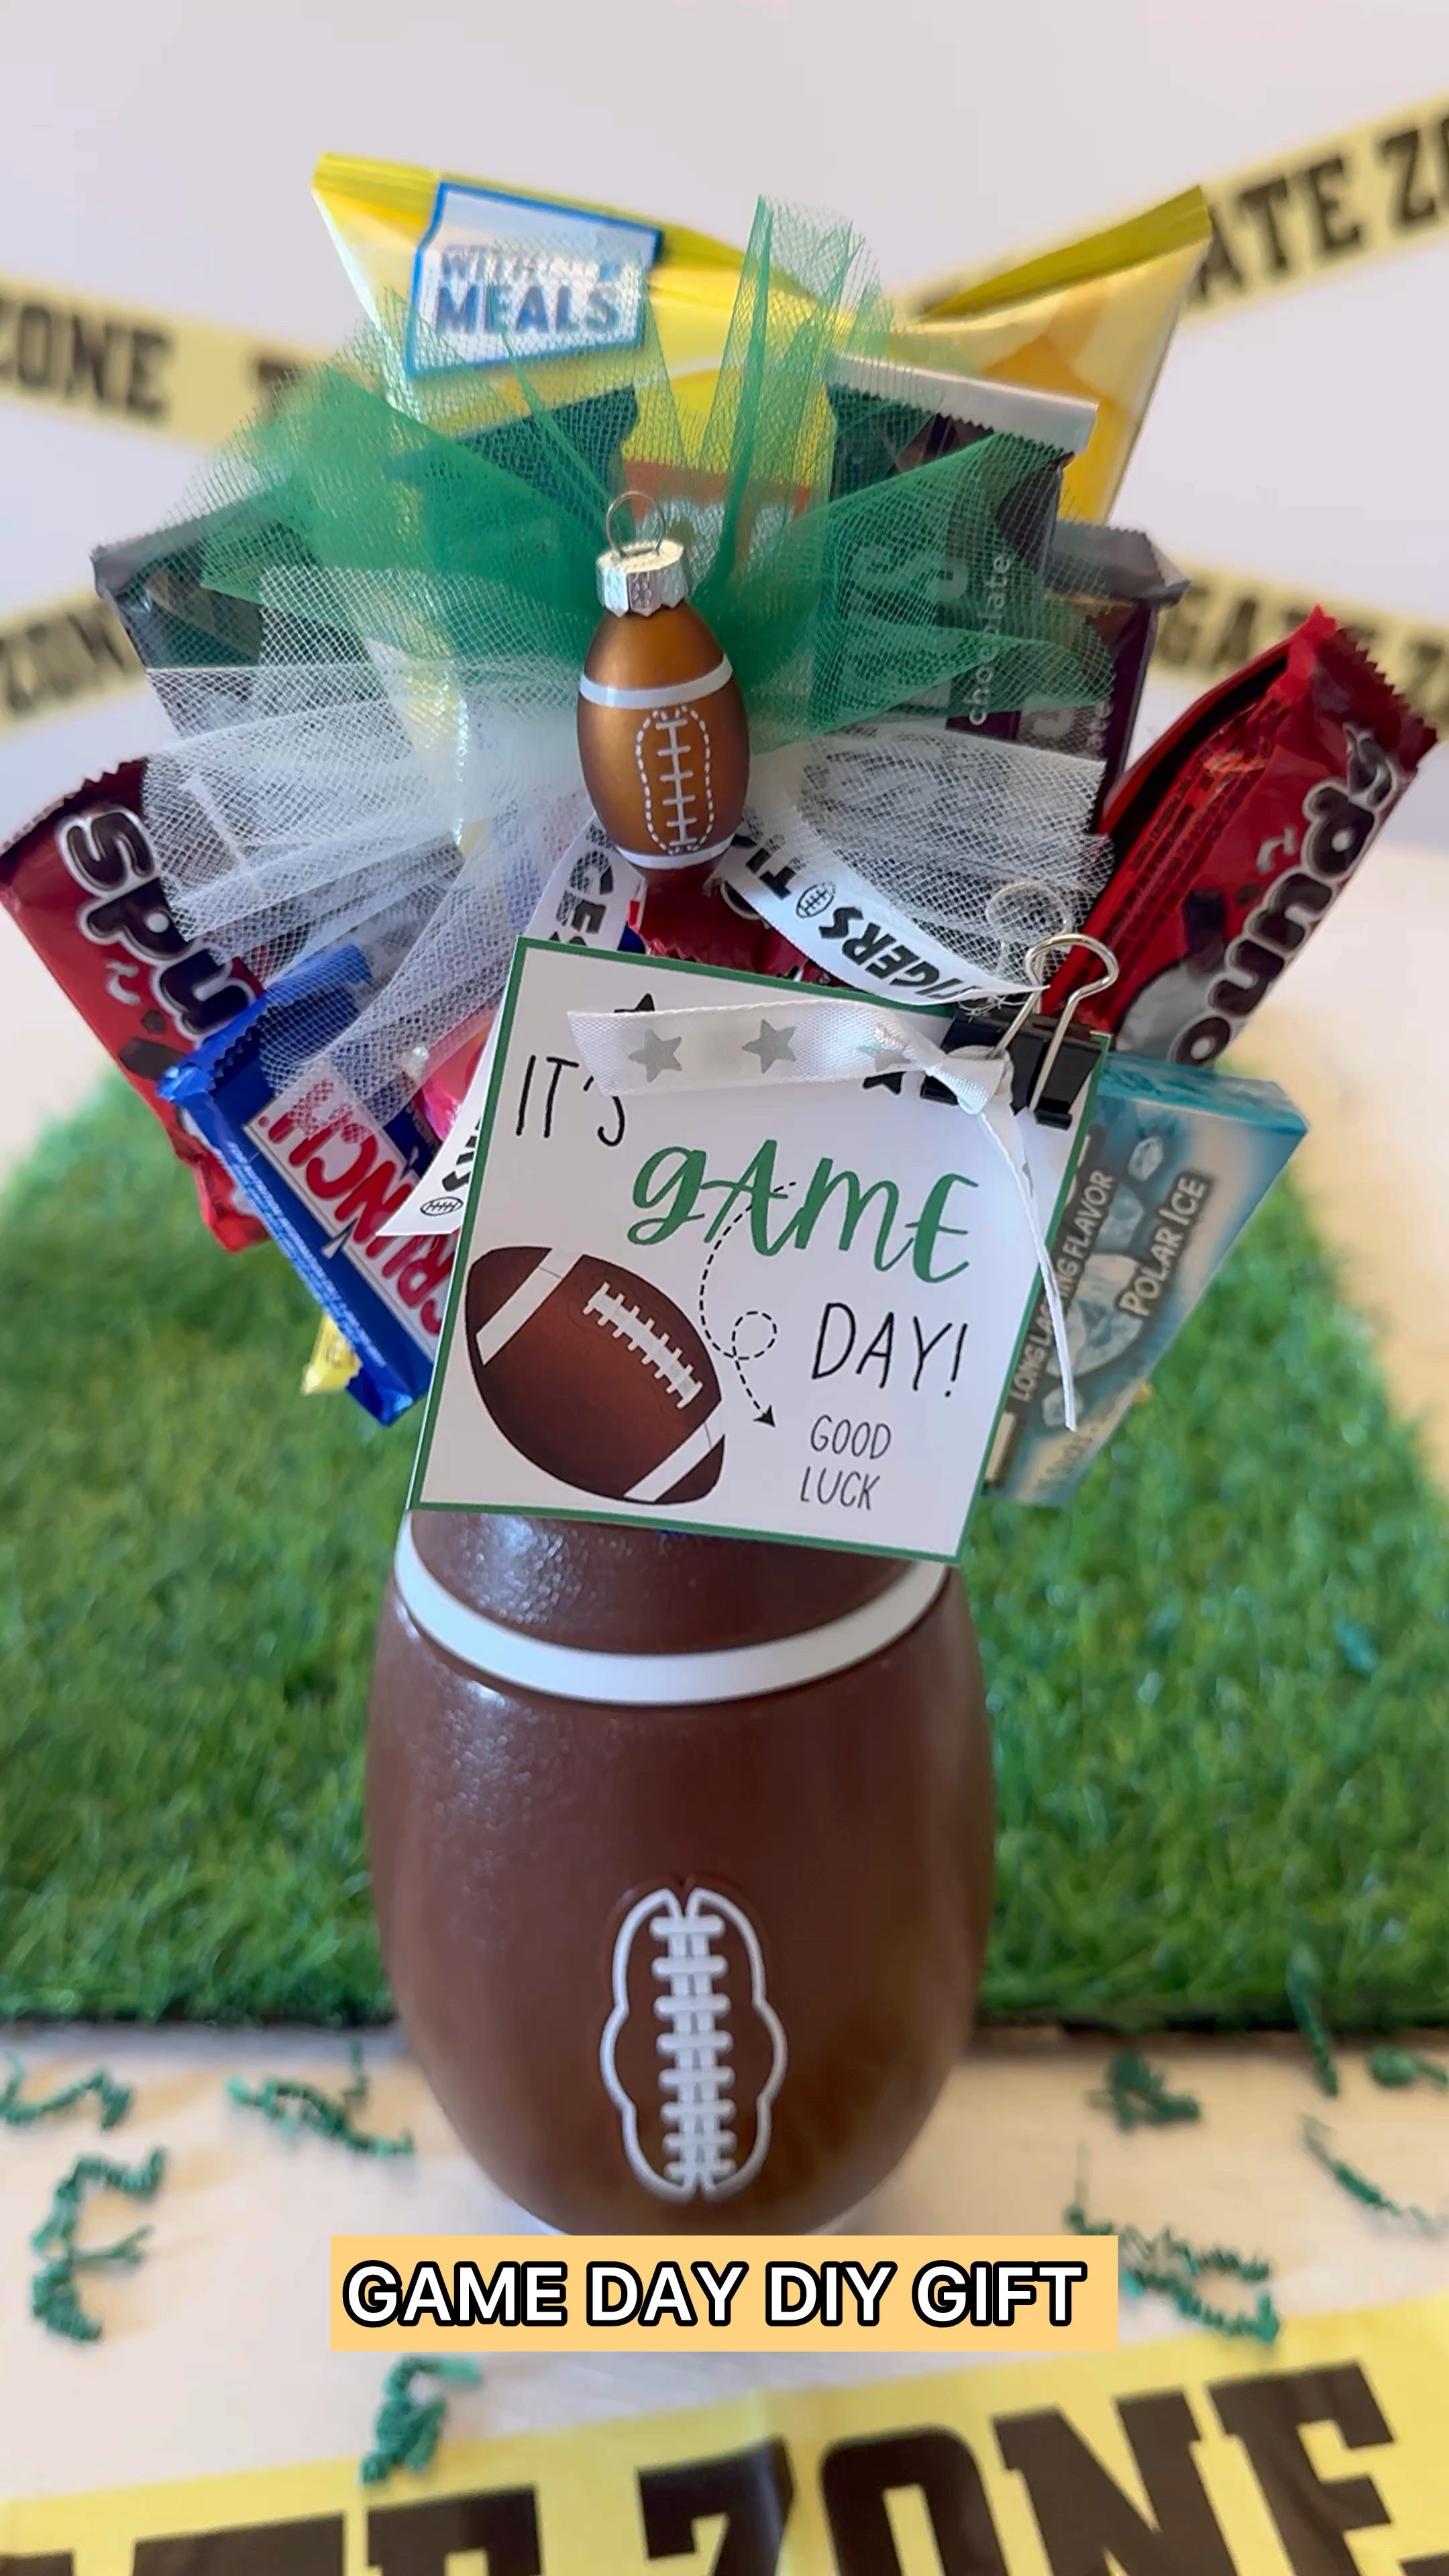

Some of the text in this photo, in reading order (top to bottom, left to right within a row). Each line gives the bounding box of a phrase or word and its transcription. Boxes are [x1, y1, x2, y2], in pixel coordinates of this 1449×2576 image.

[0, 292, 174, 421] ONE
[435, 284, 621, 334] MEALS
[1173, 723, 1399, 1070] ounds
[1062, 1167, 1116, 1261] FLAVOR
[1115, 1173, 1208, 1319] POLAR ICE
[810, 1301, 969, 1398] DAY!
[809, 1414, 892, 1461] GOOD
[800, 1465, 881, 1512] LUCK
